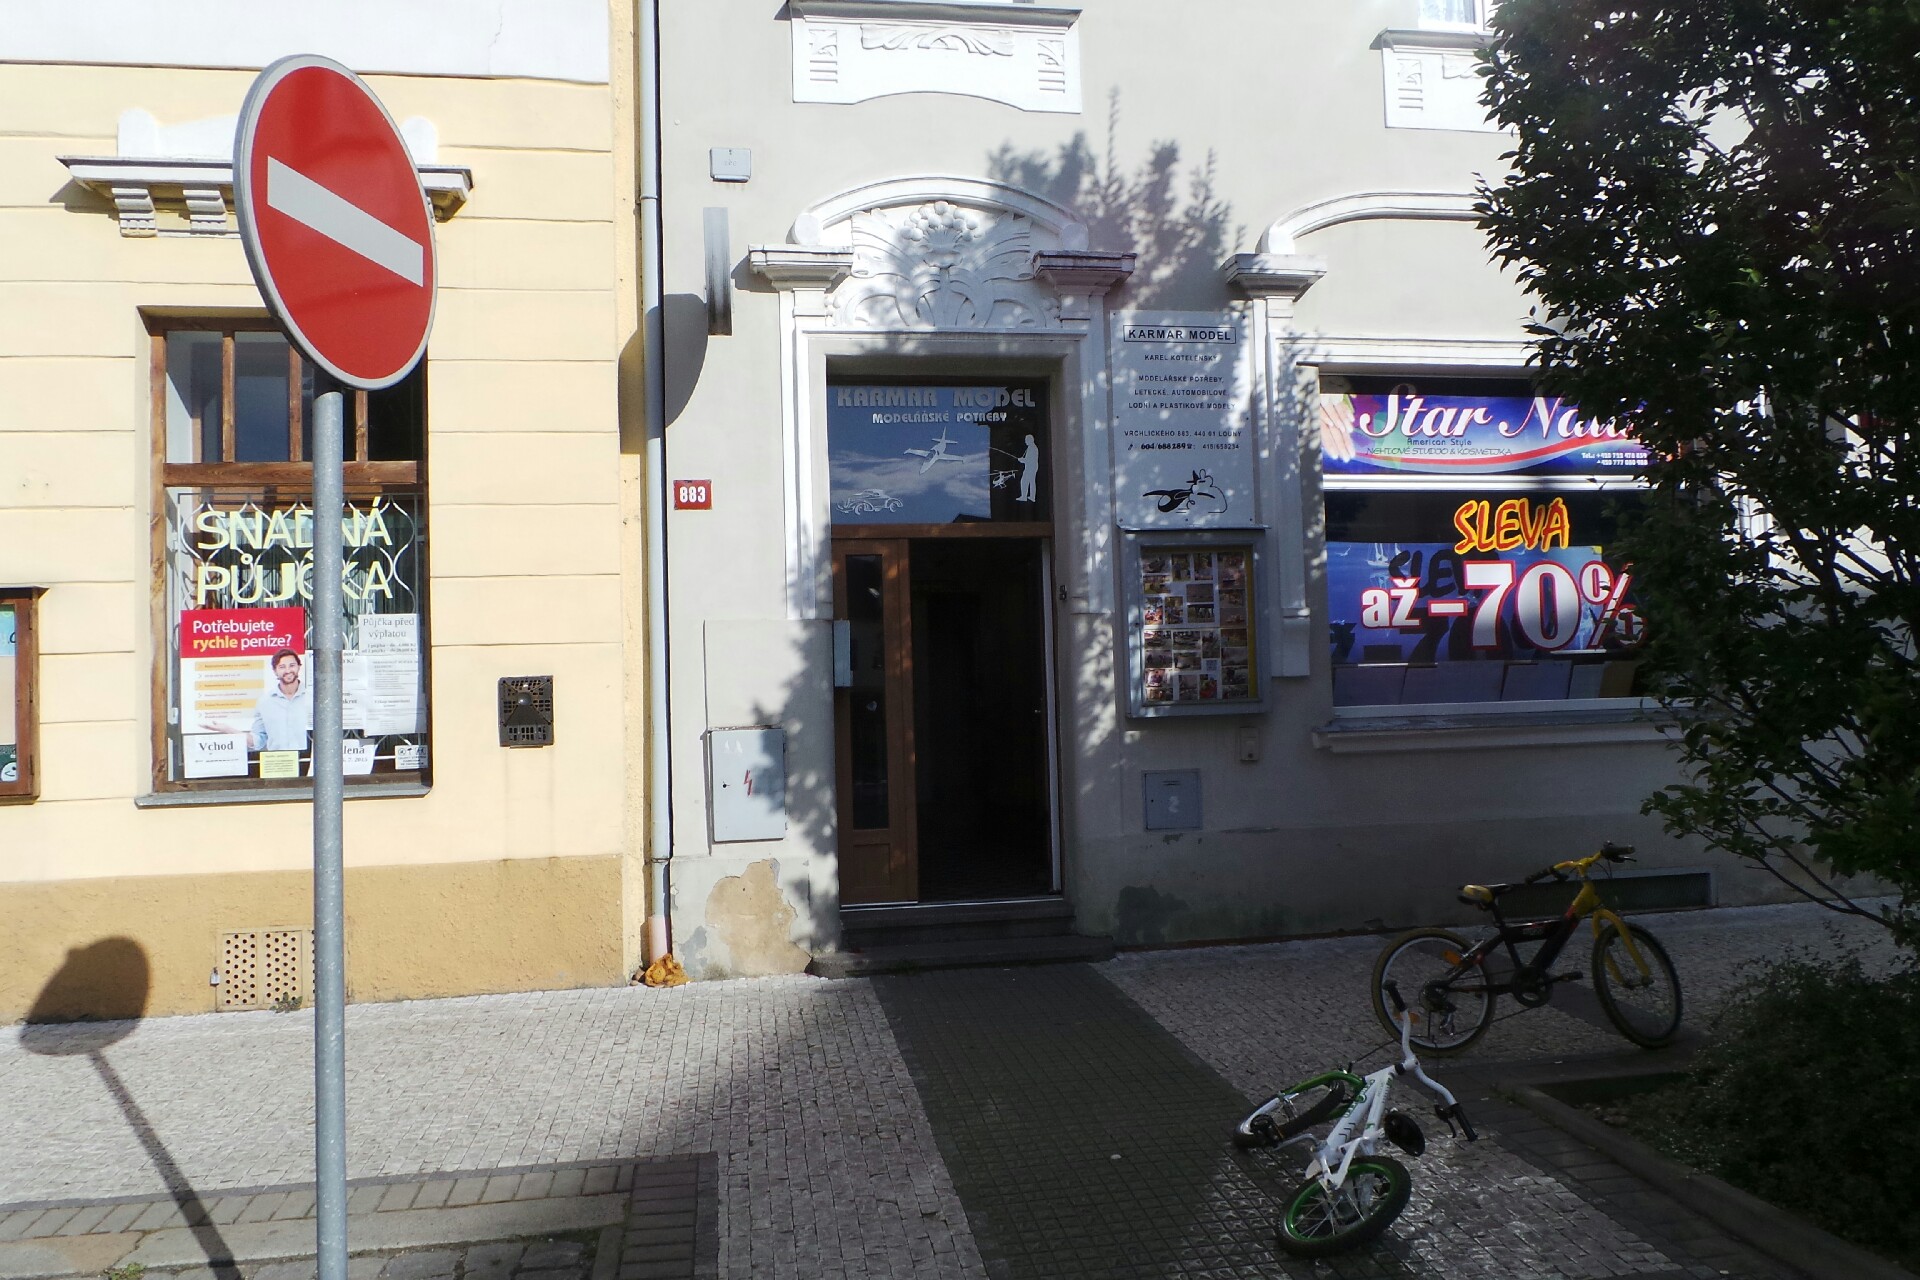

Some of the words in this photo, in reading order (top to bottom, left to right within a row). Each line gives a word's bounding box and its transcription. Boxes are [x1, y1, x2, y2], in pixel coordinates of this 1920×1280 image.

[1128, 329, 1183, 339] KARMAR
[1189, 330, 1231, 340] MODEL
[837, 386, 937, 407] KARMAR
[953, 387, 1036, 407] MODEL
[1160, 401, 1204, 409] PLASTIKOVÉ
[1359, 383, 1493, 438] Star
[1407, 438, 1446, 446] American
[1450, 437, 1472, 447] Style
[679, 486, 706, 503] 883
[1454, 497, 1571, 554] SLEVA
[193, 620, 274, 635] Potřebujete
[363, 618, 392, 628] Půjčka
[395, 617, 415, 627] před
[369, 630, 407, 639] výplatou
[193, 635, 238, 652] rychle
[240, 634, 292, 651] peníze?
[199, 741, 234, 751] Vchod
